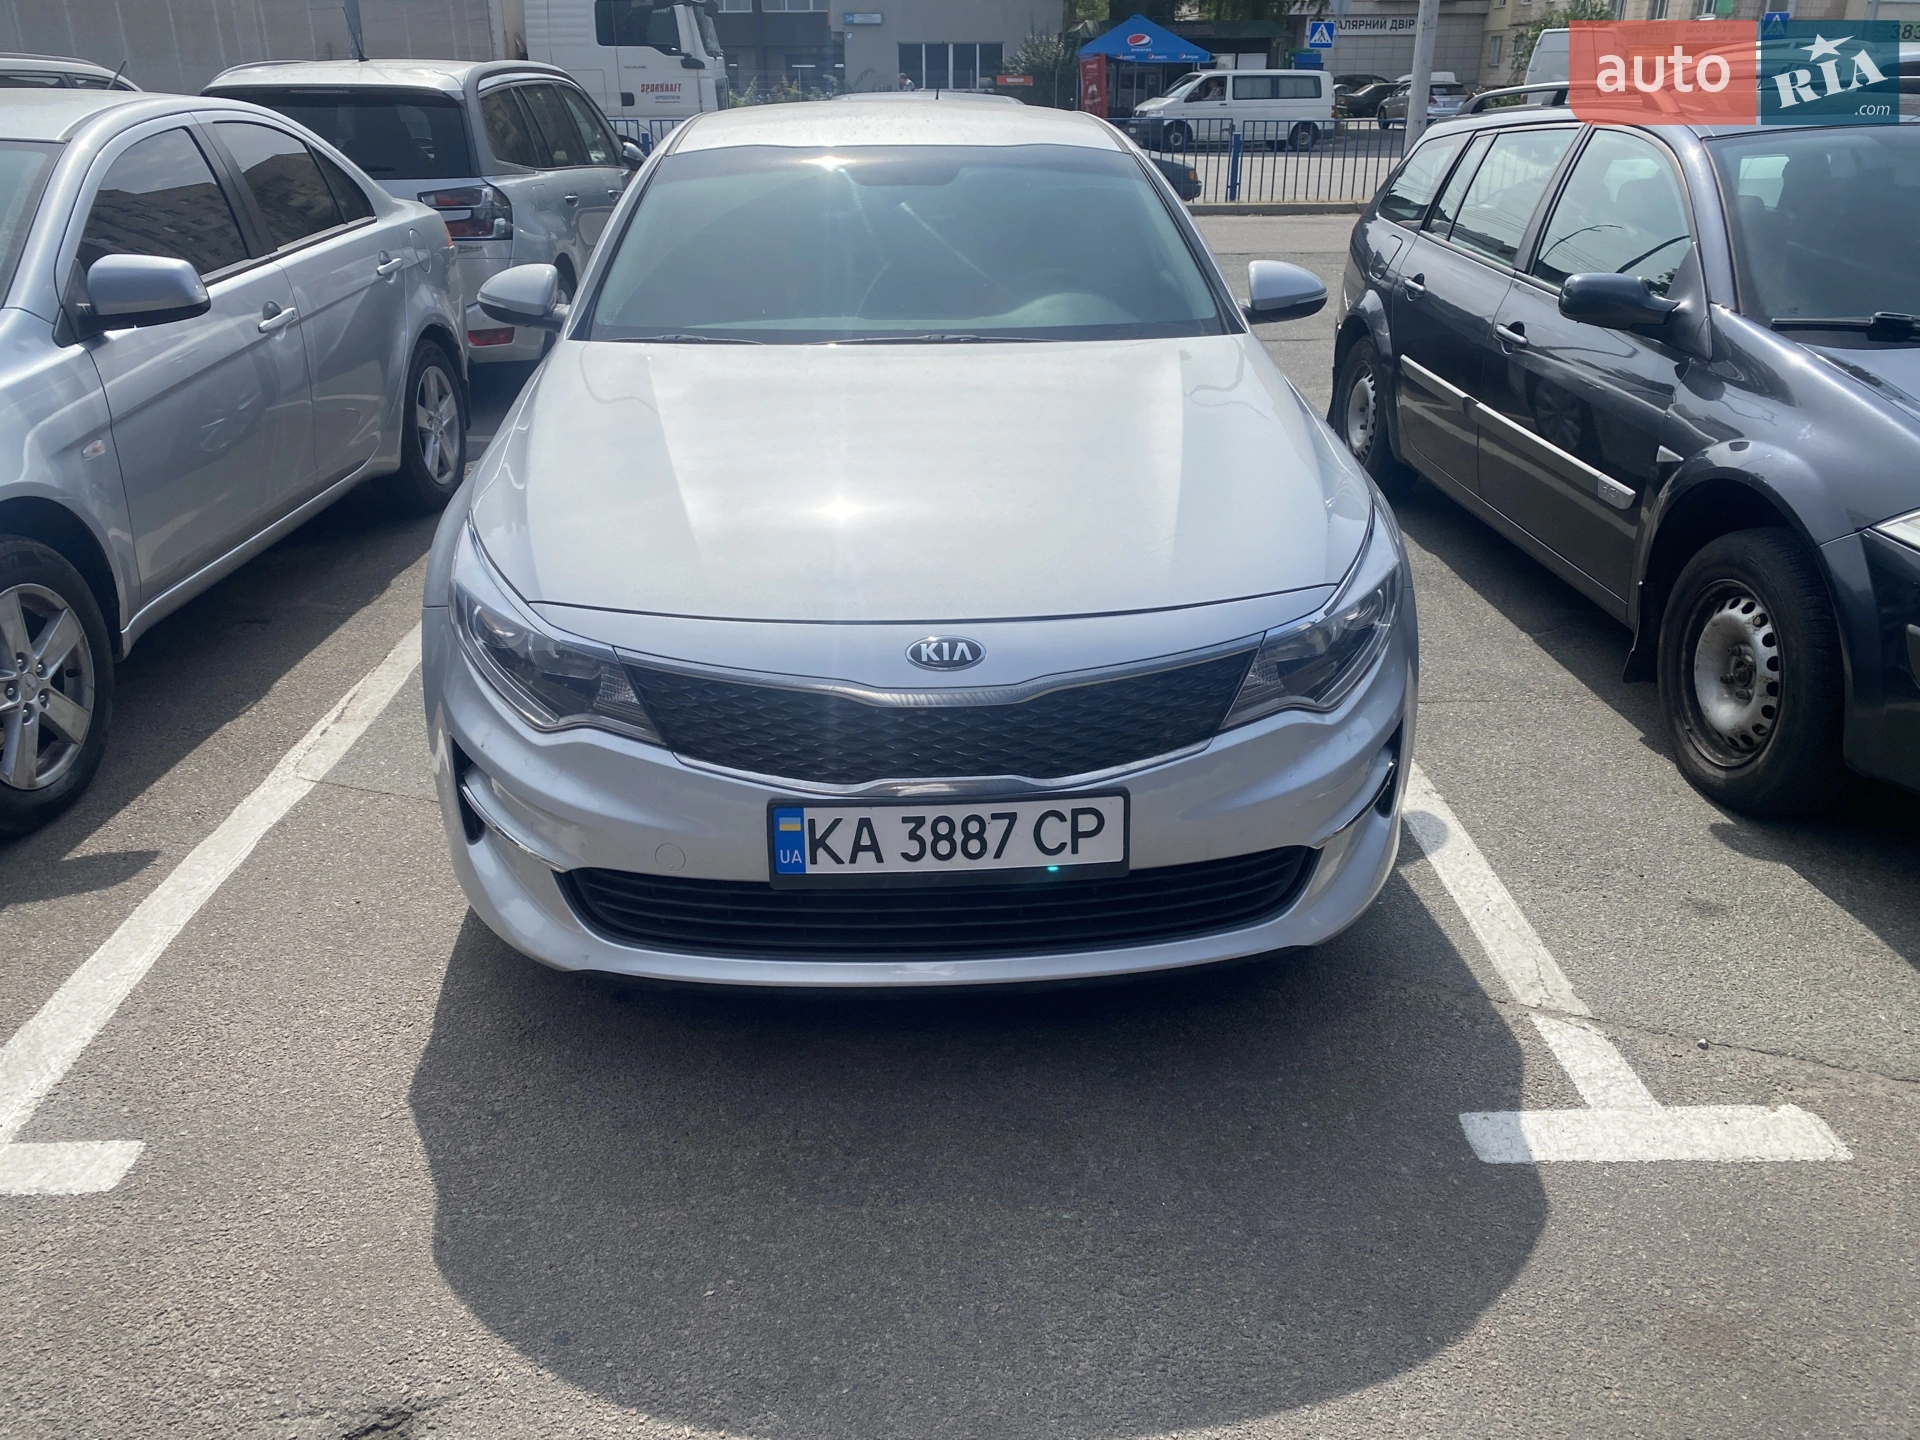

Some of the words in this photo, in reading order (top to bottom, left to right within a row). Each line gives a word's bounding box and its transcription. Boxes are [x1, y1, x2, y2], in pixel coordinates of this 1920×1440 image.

[1389, 19, 1415, 31] ДВІР
[920, 642, 973, 662] KIA
[807, 817, 885, 865] KA
[900, 812, 1017, 862] 3887
[1033, 807, 1105, 856] CP
[780, 849, 802, 865] UA
